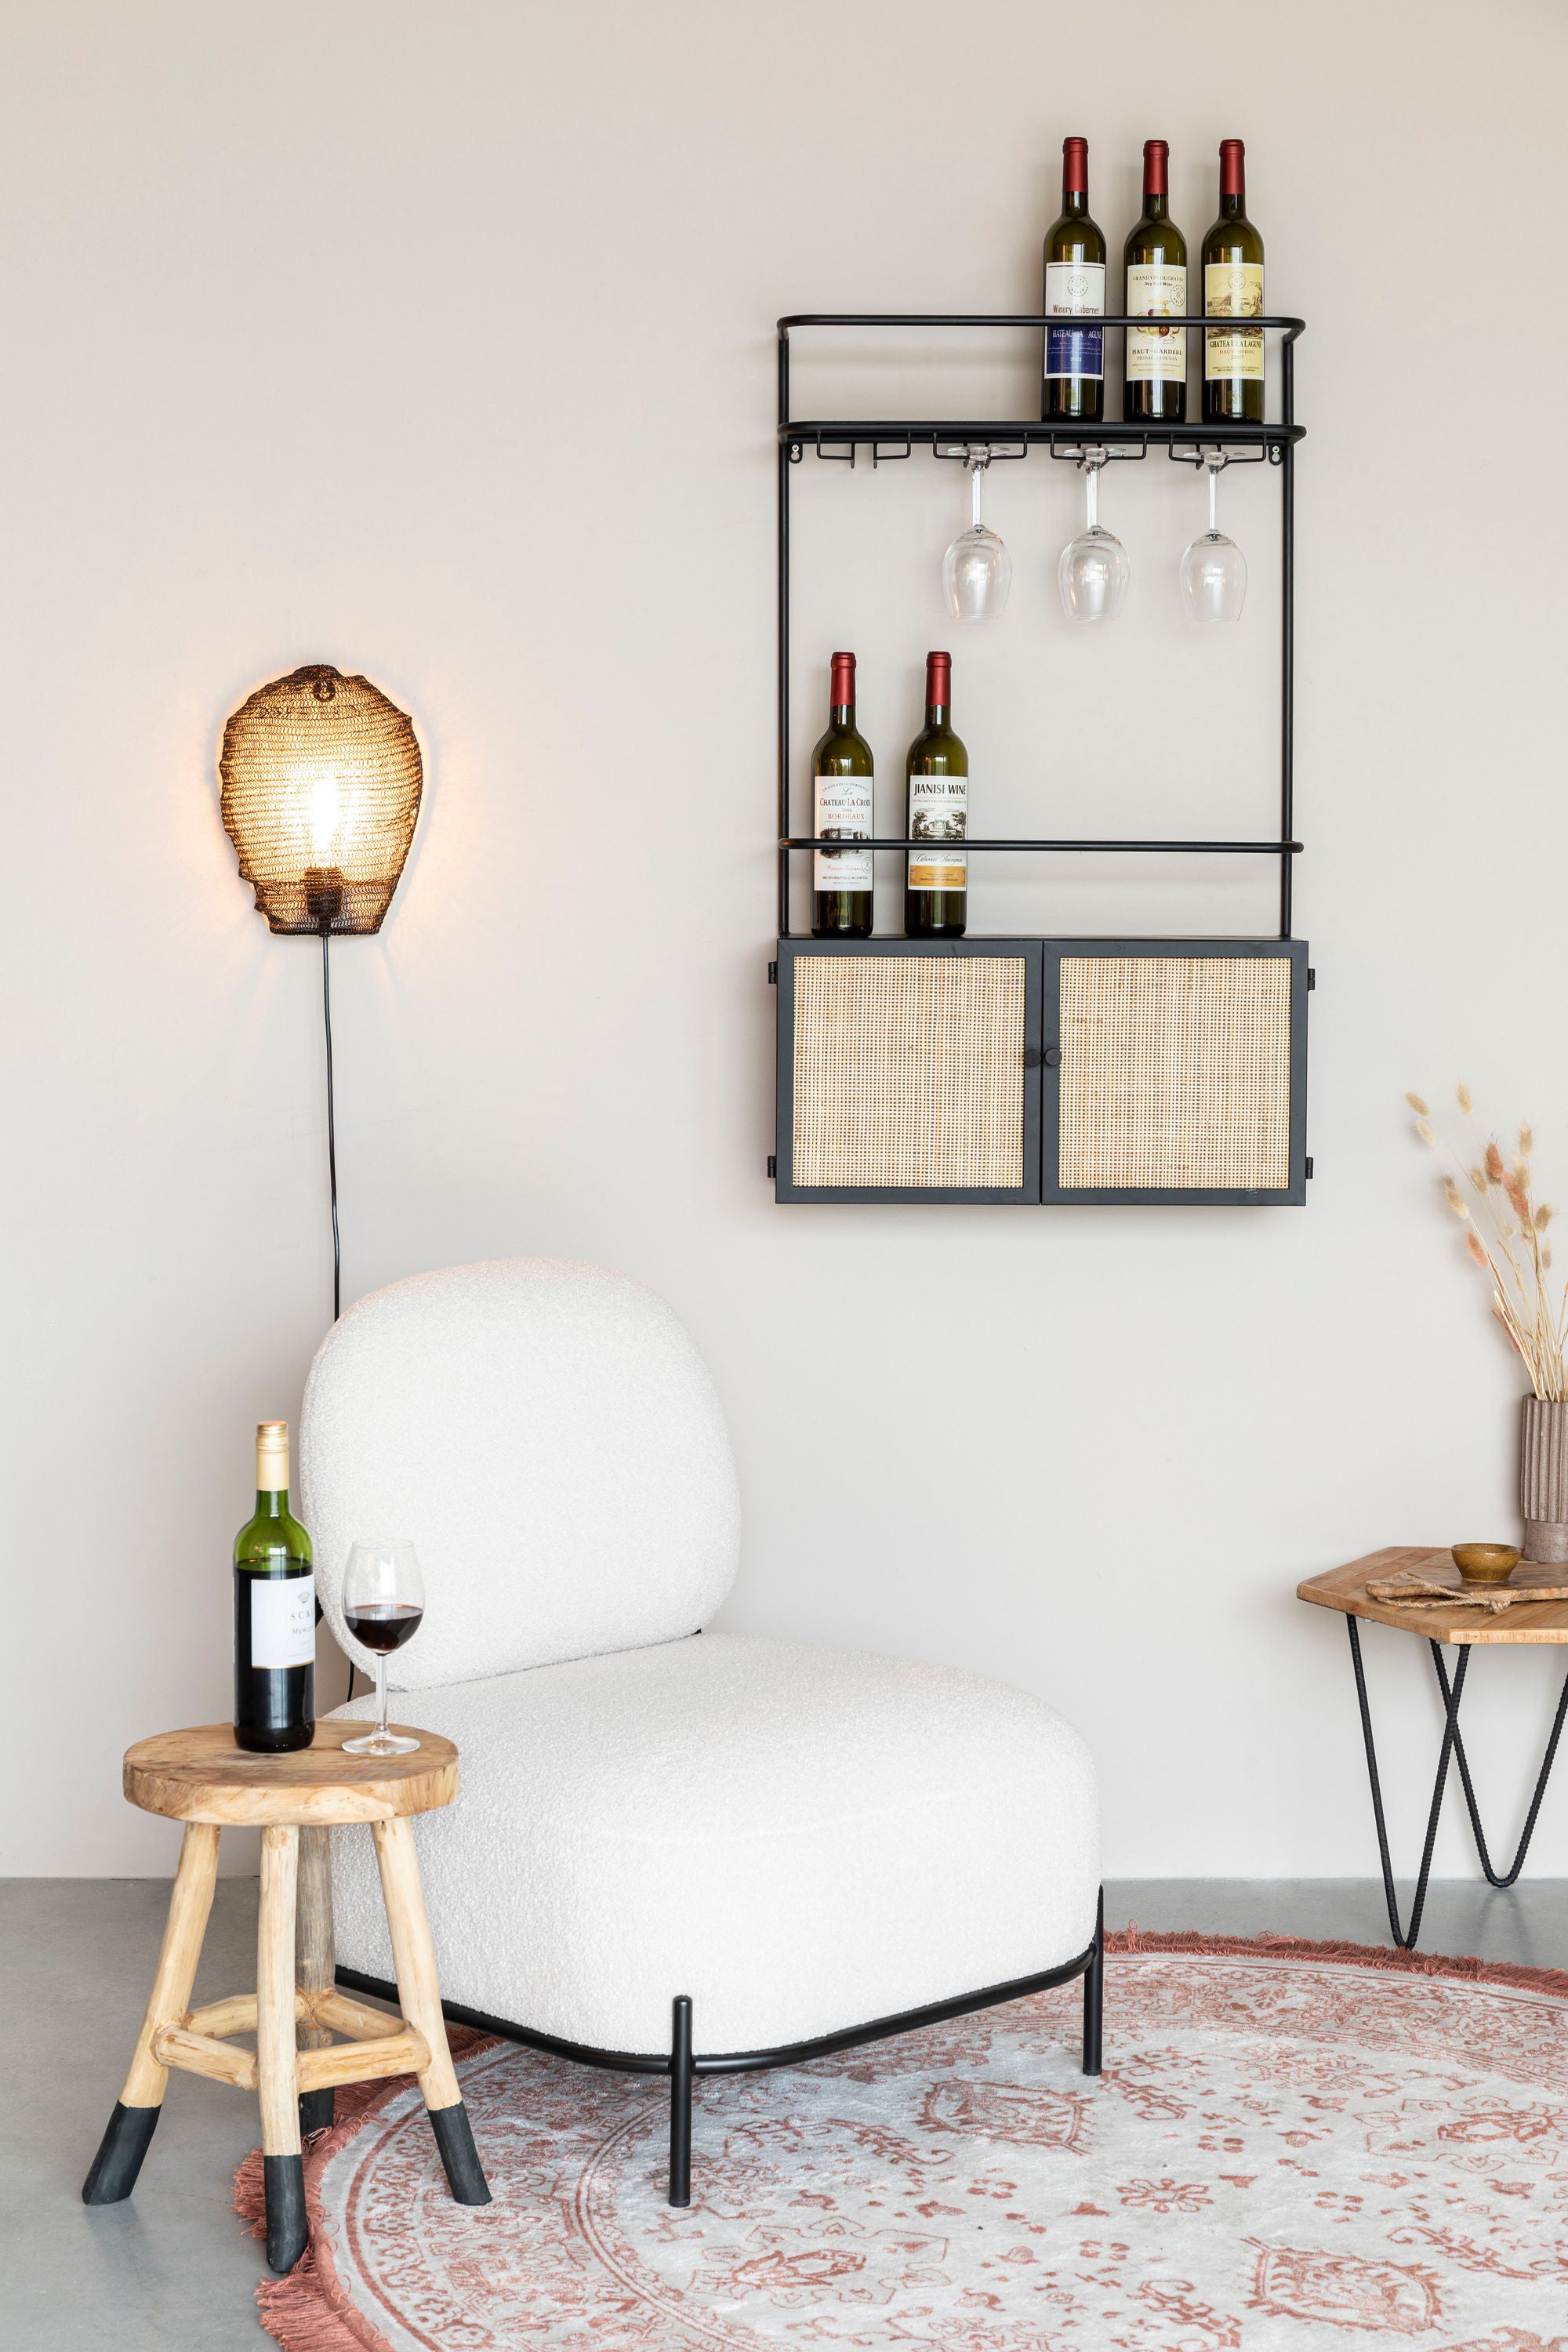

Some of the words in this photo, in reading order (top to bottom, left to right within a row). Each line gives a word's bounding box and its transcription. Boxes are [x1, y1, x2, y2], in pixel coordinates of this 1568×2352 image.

[1053, 304, 1073, 314] Winery
[1075, 304, 1099, 314] Cabernet
[1052, 329, 1073, 338] HATEAU
[913, 783, 945, 796] JIANISI
[948, 784, 967, 795] WINE
[819, 797, 847, 806] CHATEAU
